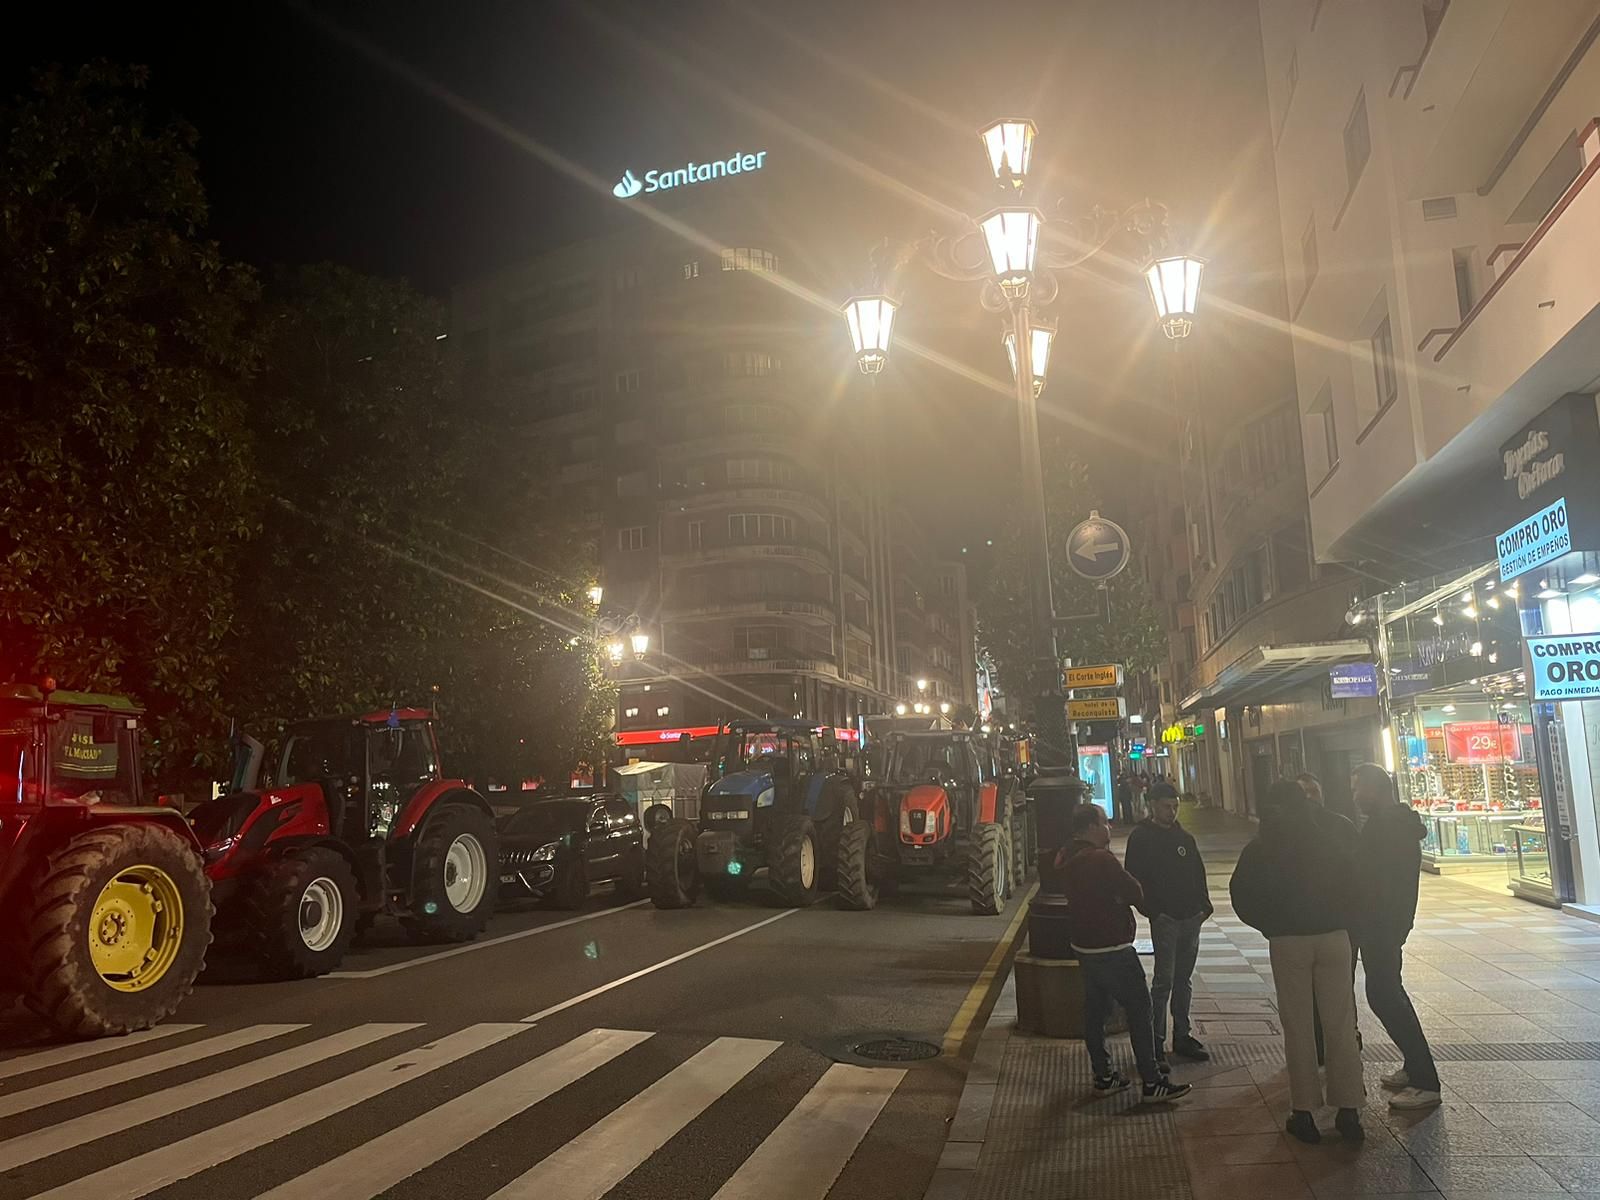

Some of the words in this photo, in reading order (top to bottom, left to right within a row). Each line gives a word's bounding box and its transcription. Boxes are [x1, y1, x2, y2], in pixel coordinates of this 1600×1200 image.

[645, 151, 767, 193] Santander
[1499, 520, 1539, 559] COMPRO
[1542, 505, 1566, 536] ORO
[1501, 554, 1527, 577] GESTIÓN
[1527, 551, 1537, 564] DE
[1537, 533, 1569, 560] EMPEÑOS
[1076, 672, 1094, 681] Corte
[1094, 671, 1114, 682] Inglés
[1546, 659, 1600, 683] ORO
[1072, 709, 1117, 718] Reconquista
